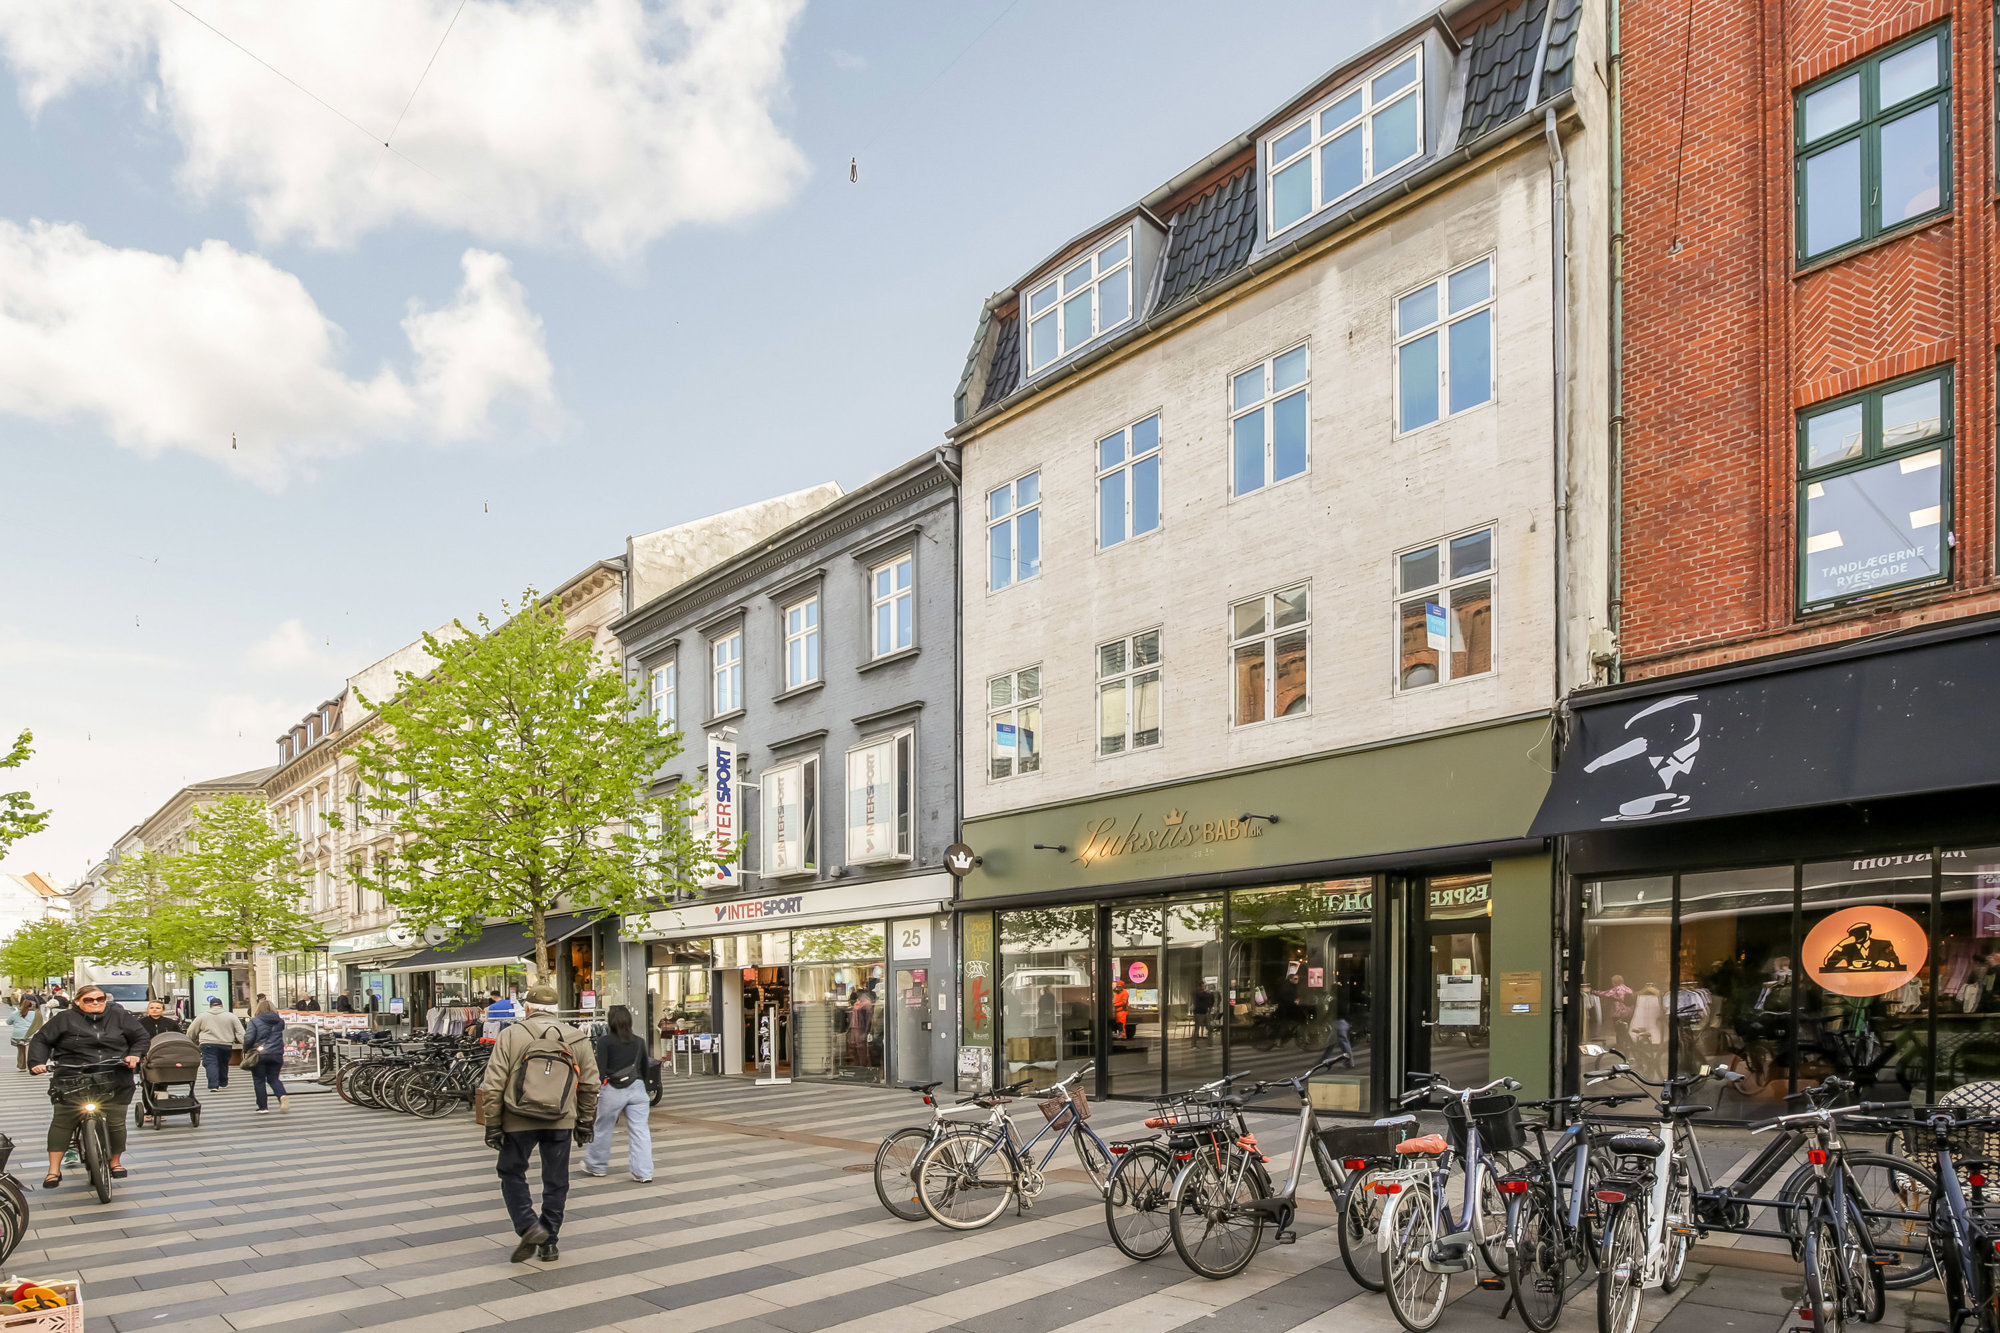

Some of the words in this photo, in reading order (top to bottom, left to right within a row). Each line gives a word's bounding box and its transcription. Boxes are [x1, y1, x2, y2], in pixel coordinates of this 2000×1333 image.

[1822, 546, 1925, 578] TANDLÆGERNE
[1837, 563, 1908, 587] RYESGADE
[866, 753, 875, 836] INTERSPORT
[777, 776, 785, 852] INTERSPORT
[728, 897, 802, 920] INTERSPORT
[902, 929, 921, 948] 25
